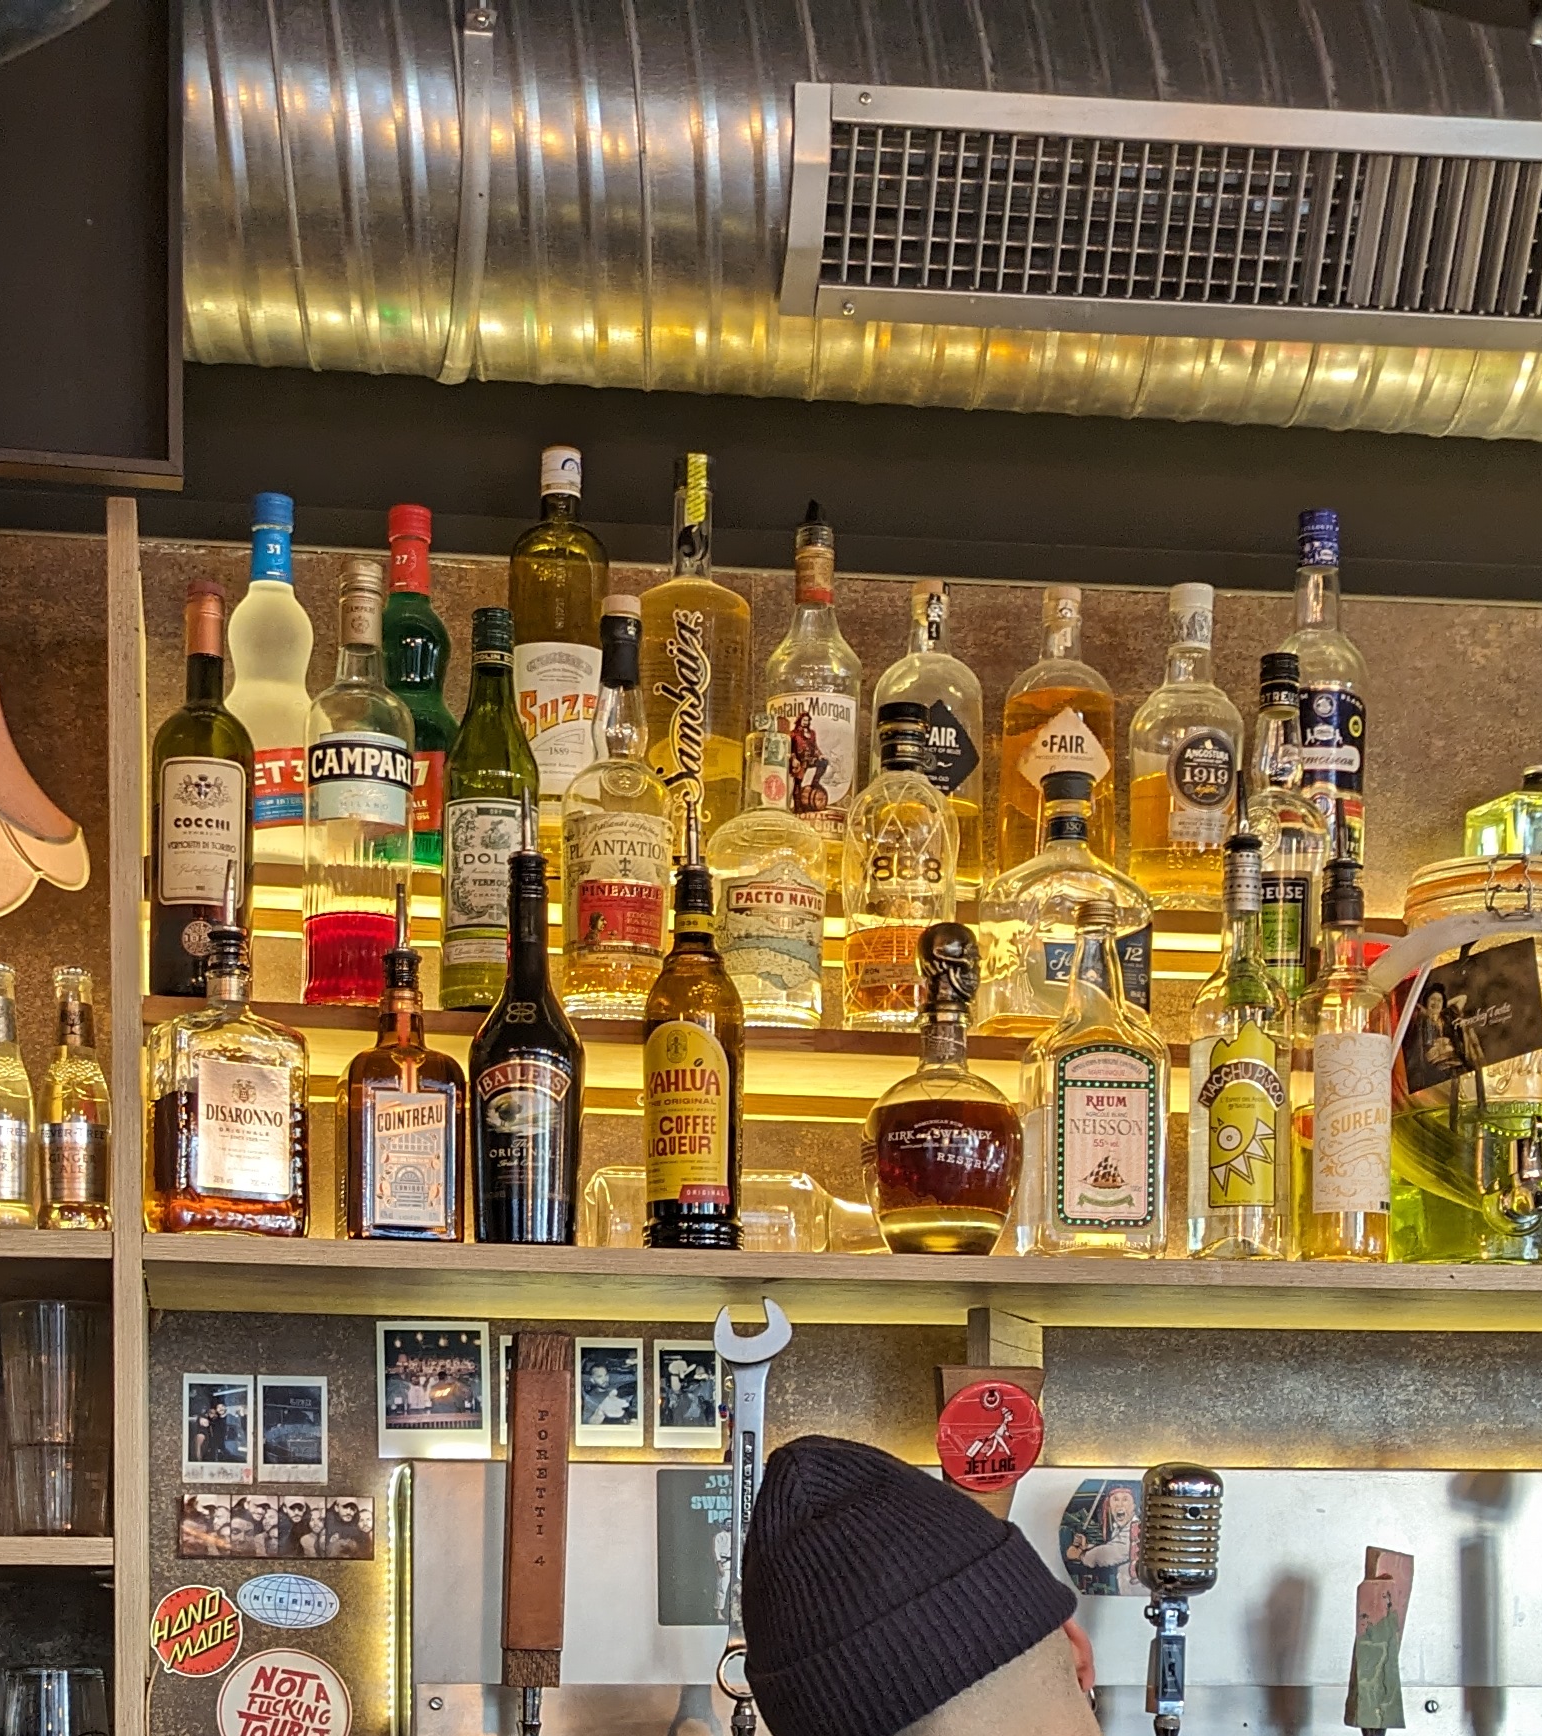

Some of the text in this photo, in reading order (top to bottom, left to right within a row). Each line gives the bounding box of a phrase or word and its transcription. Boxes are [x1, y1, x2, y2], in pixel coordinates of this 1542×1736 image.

[266, 543, 281, 555] 31
[809, 697, 852, 722] Morgan
[549, 747, 570, 757] 1889
[1185, 748, 1230, 761] ANGOSTURA
[312, 748, 411, 784] CAMPARI
[1181, 765, 1229, 785] 1919
[174, 817, 230, 832] COCCHI
[569, 839, 668, 861] PLANTATION
[581, 883, 663, 899] PINEAPPLE
[735, 890, 823, 912] PACTO NAVIO
[1123, 947, 1143, 962] 12
[482, 1062, 566, 1090] BAILEYS
[1198, 1062, 1284, 1107] MACCHU PISCO
[1086, 1094, 1128, 1109] RHUM
[206, 1104, 284, 1128] DISARONNO
[377, 1104, 443, 1132] COINTREAU
[660, 1116, 717, 1135] COFFEE
[1330, 1108, 1388, 1136] SUREAU
[888, 1130, 915, 1142] KIRK
[933, 1127, 992, 1141] SWEENEY
[1069, 1118, 1144, 1137] NEISSON
[648, 1136, 712, 1157] LIQUEUR
[60, 1163, 84, 1174] ALE
[936, 1152, 999, 1173] RESERVA
[687, 1189, 725, 1198] ORIGINAL
[744, 1393, 756, 1402] 27
[964, 1457, 1016, 1475] JET LAG
[243, 1592, 335, 1610] INTERNET
[153, 1591, 221, 1644] HAND
[167, 1613, 237, 1668] MADE
[251, 1666, 331, 1704] NOT A
[247, 1694, 331, 1726] FUCKING
